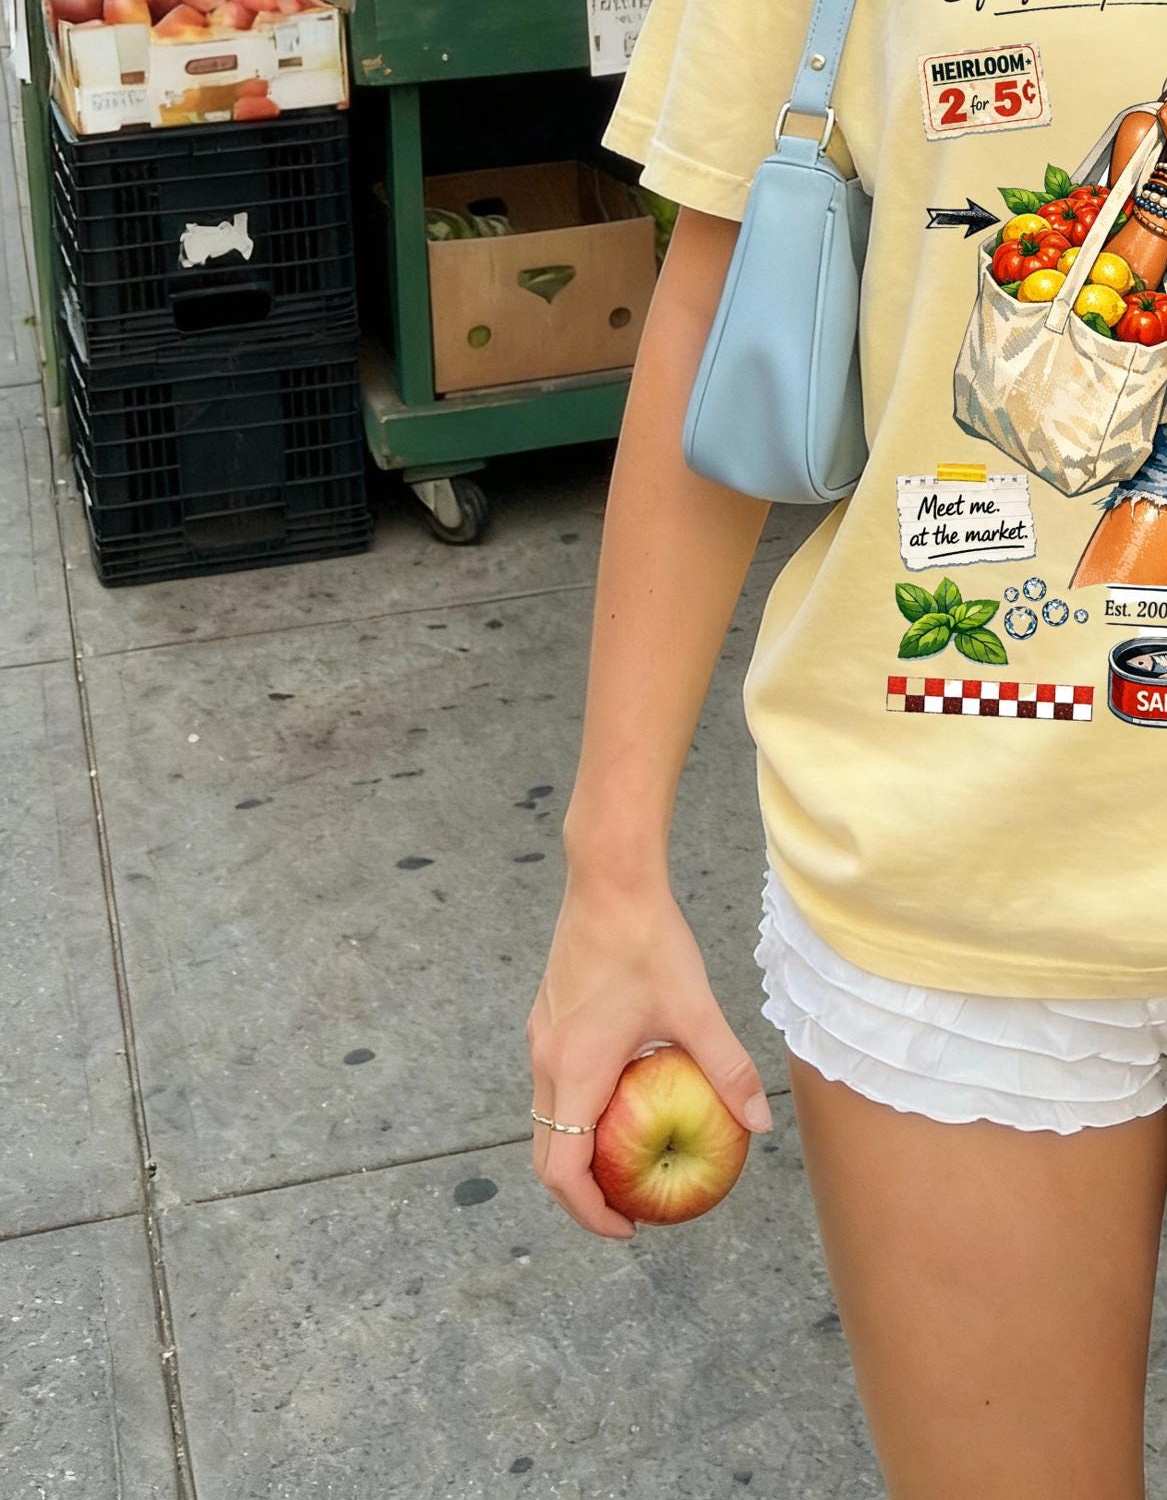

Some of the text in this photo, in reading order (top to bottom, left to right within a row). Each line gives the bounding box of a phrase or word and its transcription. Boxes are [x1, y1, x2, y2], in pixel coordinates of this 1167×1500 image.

[938, 78, 1037, 125] 2 for 5¢
[917, 493, 1000, 521] Meet me.
[909, 520, 1029, 547] at the market.
[1104, 599, 1132, 618] Est.
